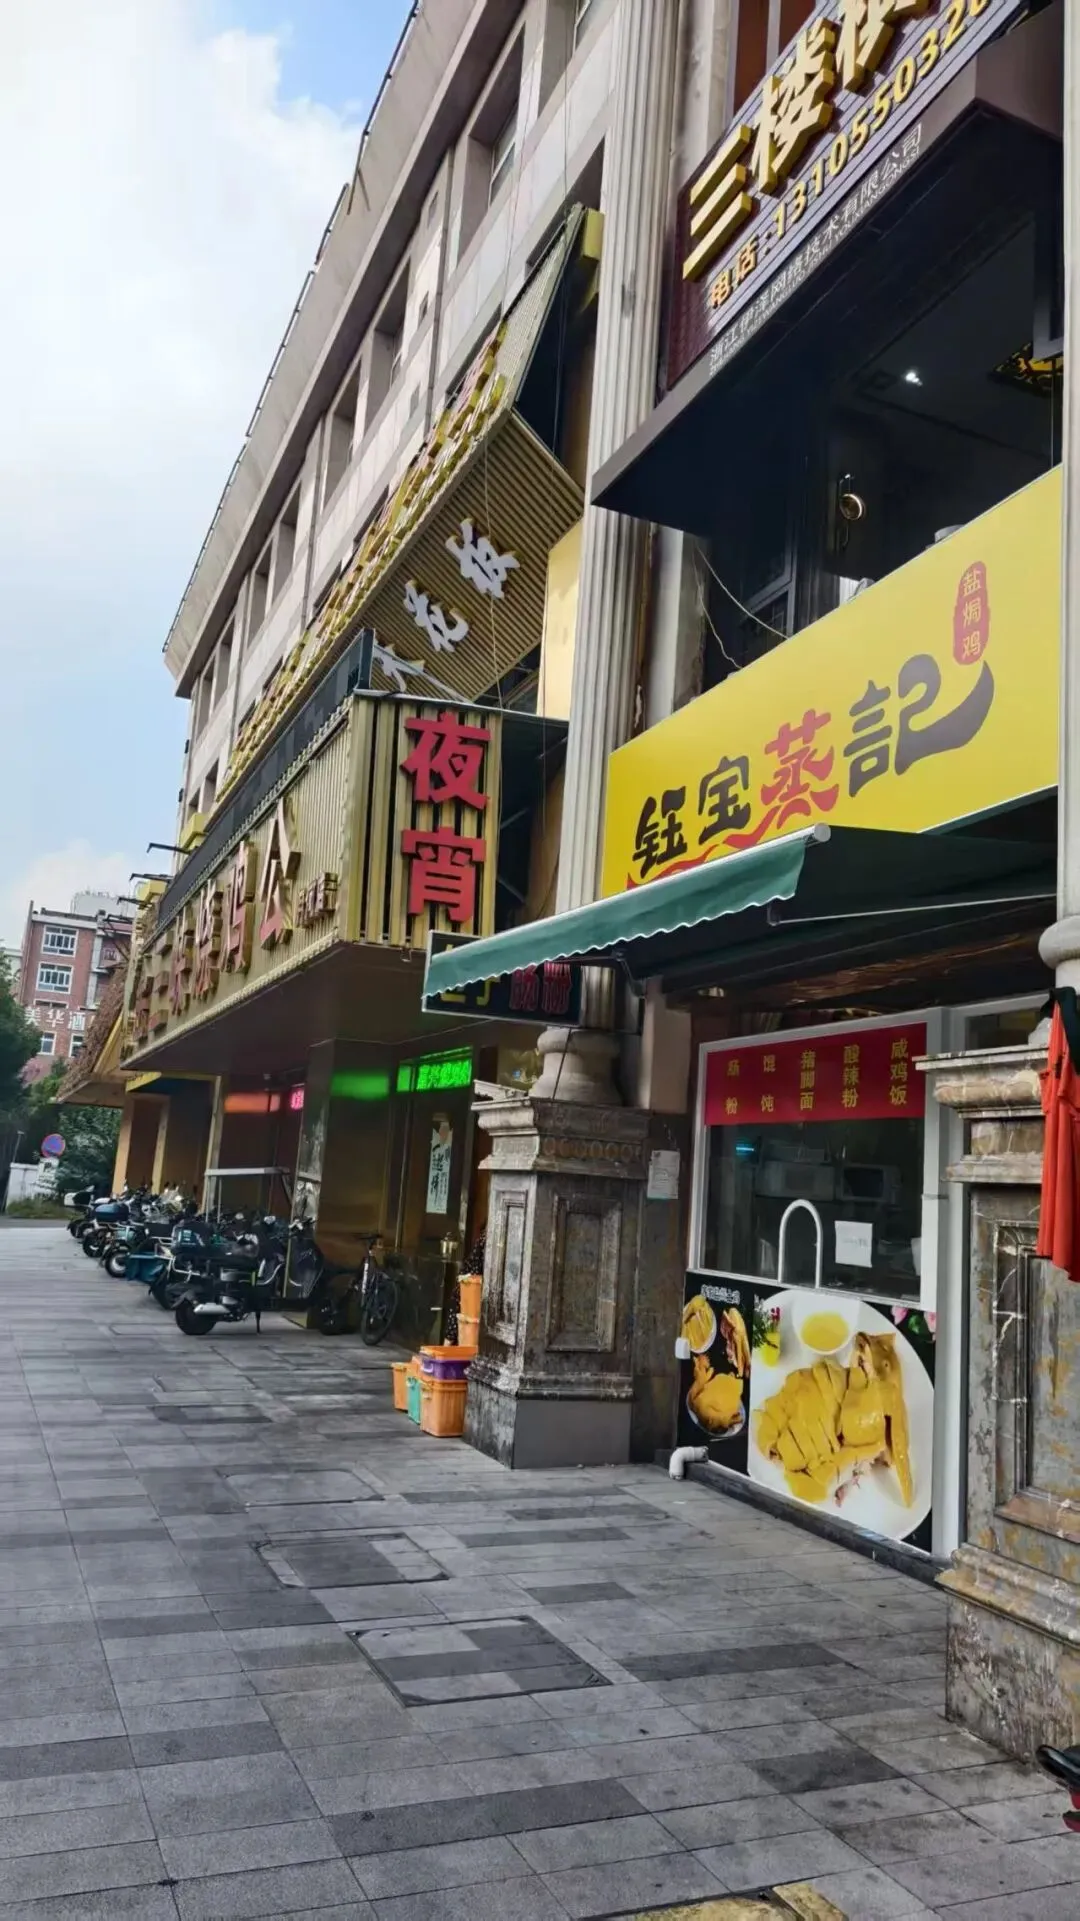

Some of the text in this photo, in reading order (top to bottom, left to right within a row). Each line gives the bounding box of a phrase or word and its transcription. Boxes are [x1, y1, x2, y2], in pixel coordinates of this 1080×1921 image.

[962, 568, 983, 661] 盐焗鸡
[400, 710, 492, 923] 夜宵
[24, 1004, 95, 1032] 美华酒
[761, 1054, 776, 1113] 馄饨
[800, 1050, 816, 1111] 猪脚面
[842, 1044, 859, 1108] 酸辣粉
[889, 1038, 909, 1106] 咸鸡饭
